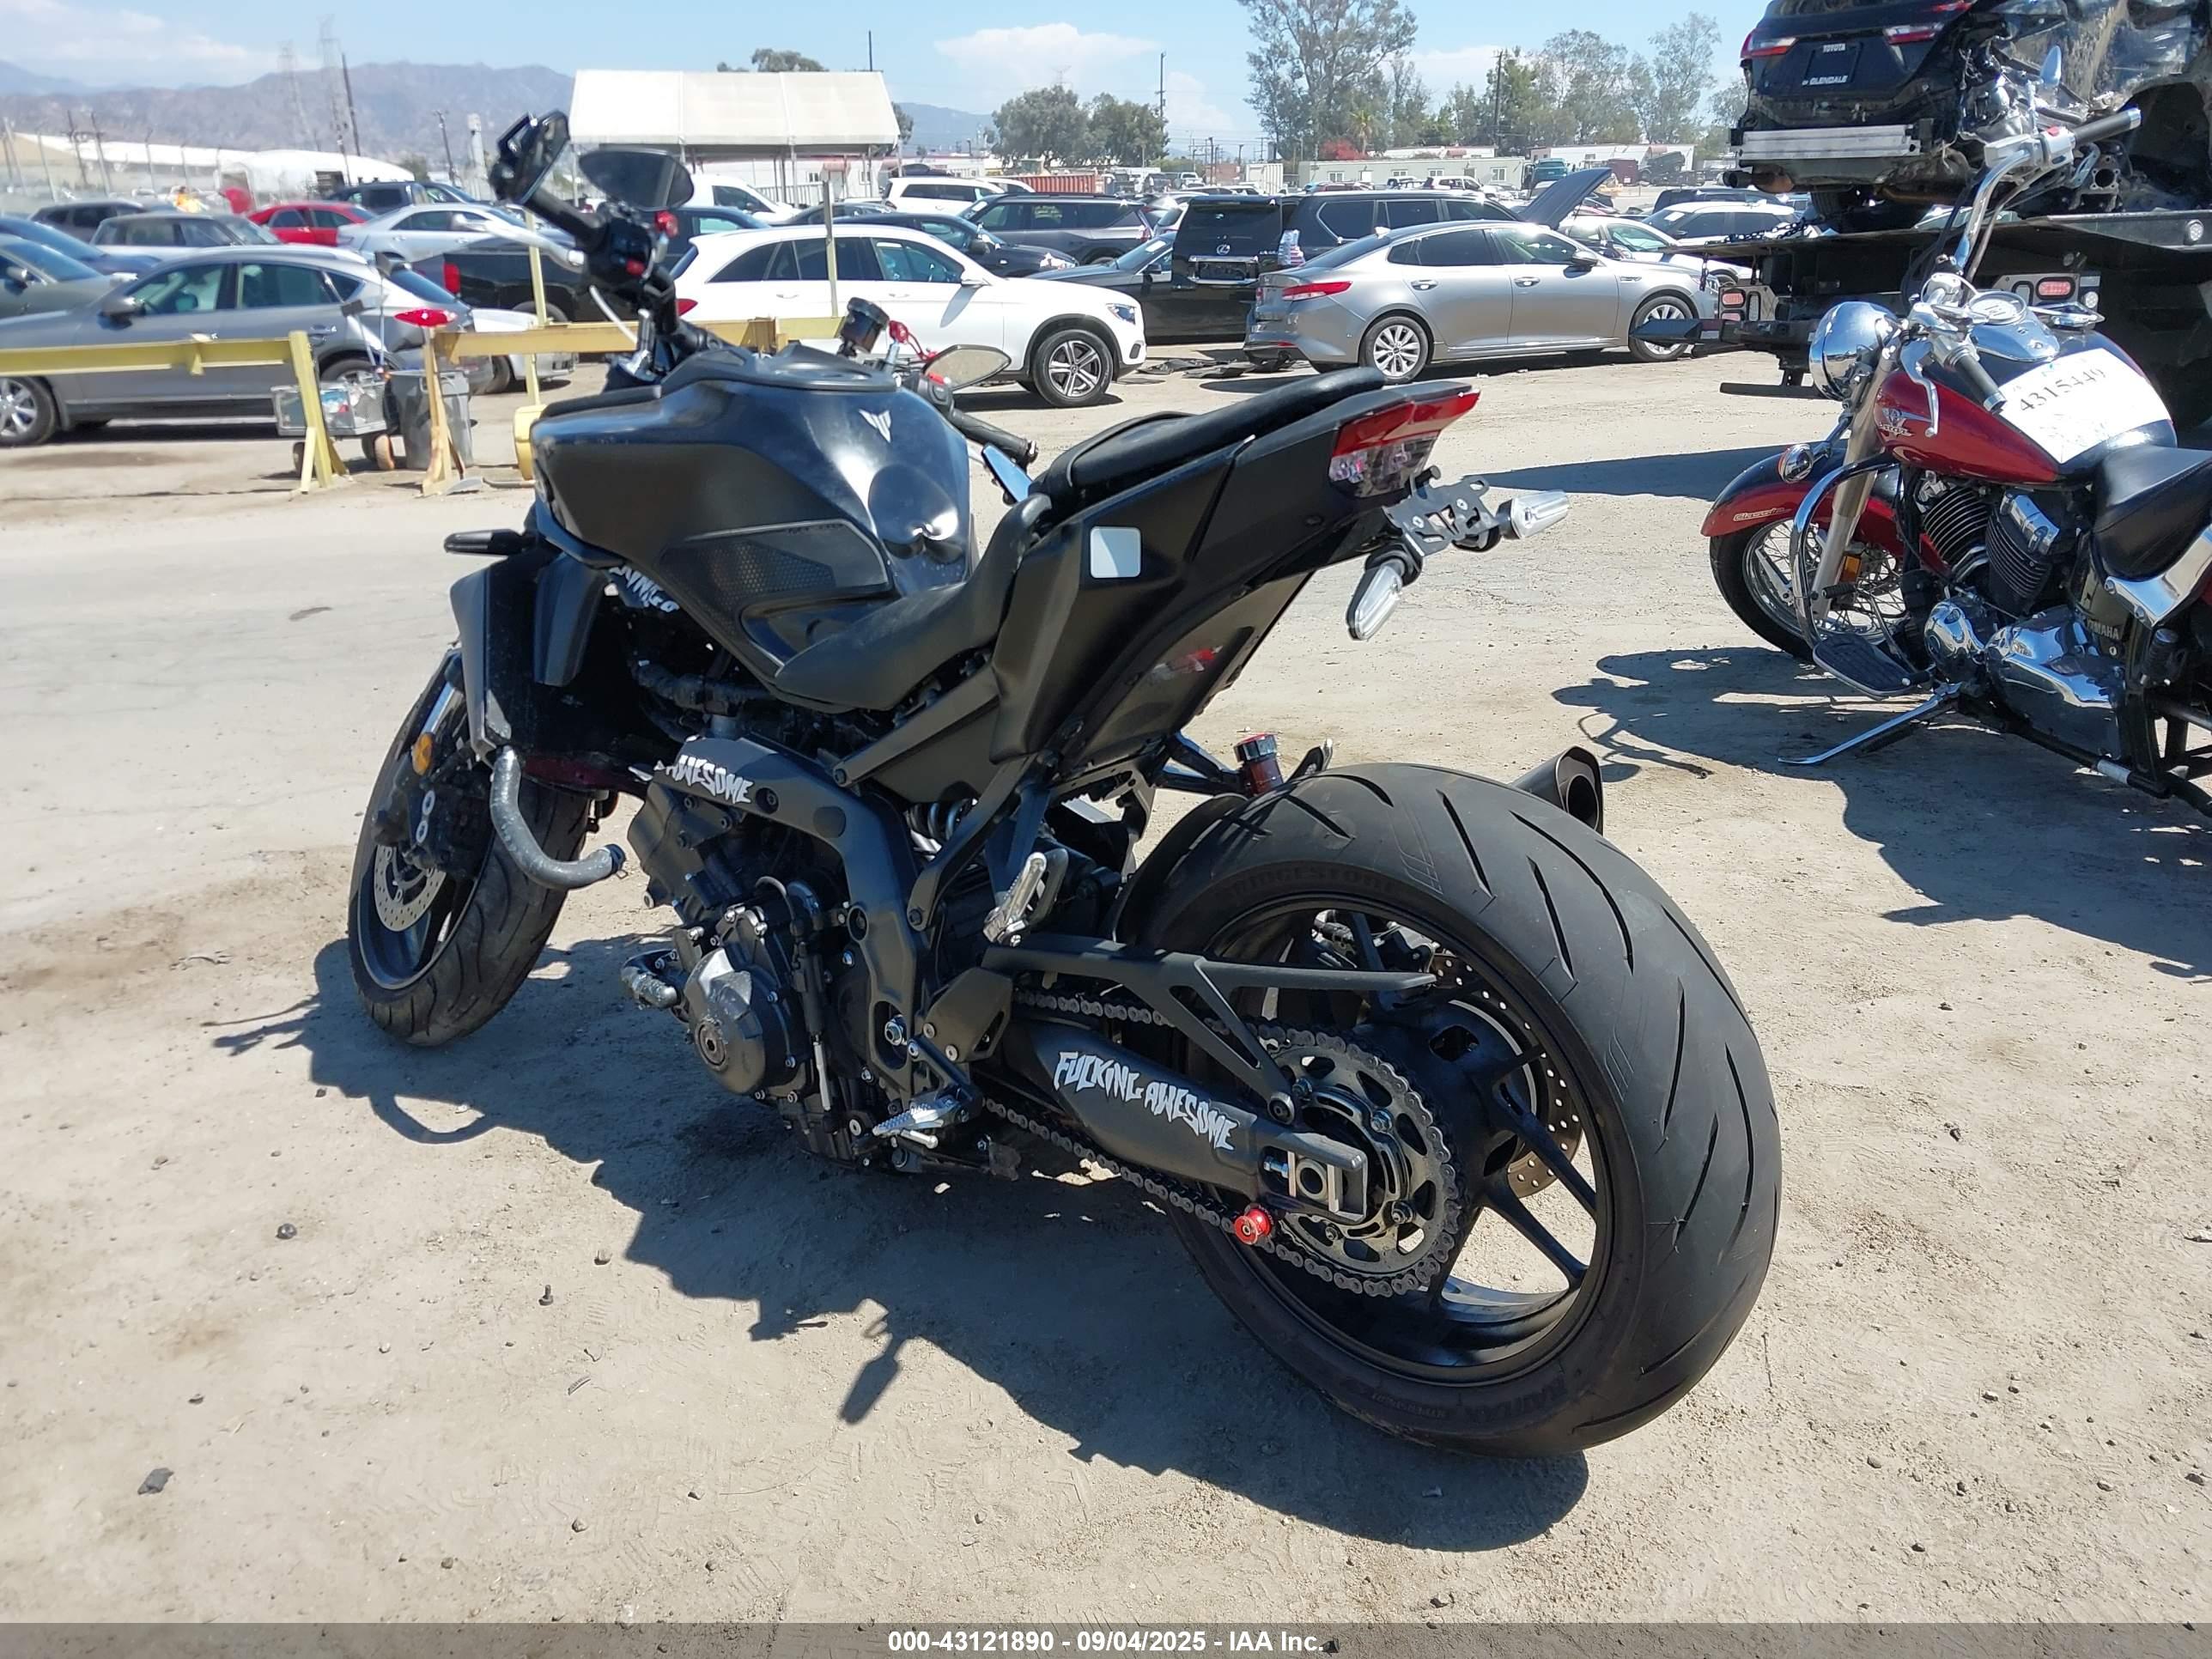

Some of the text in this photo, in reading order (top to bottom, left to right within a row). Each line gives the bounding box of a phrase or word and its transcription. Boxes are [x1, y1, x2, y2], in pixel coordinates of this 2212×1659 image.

[1809, 75, 1848, 85] GLENDALE
[1054, 1051, 1239, 1152] FUCKING AWESOME
